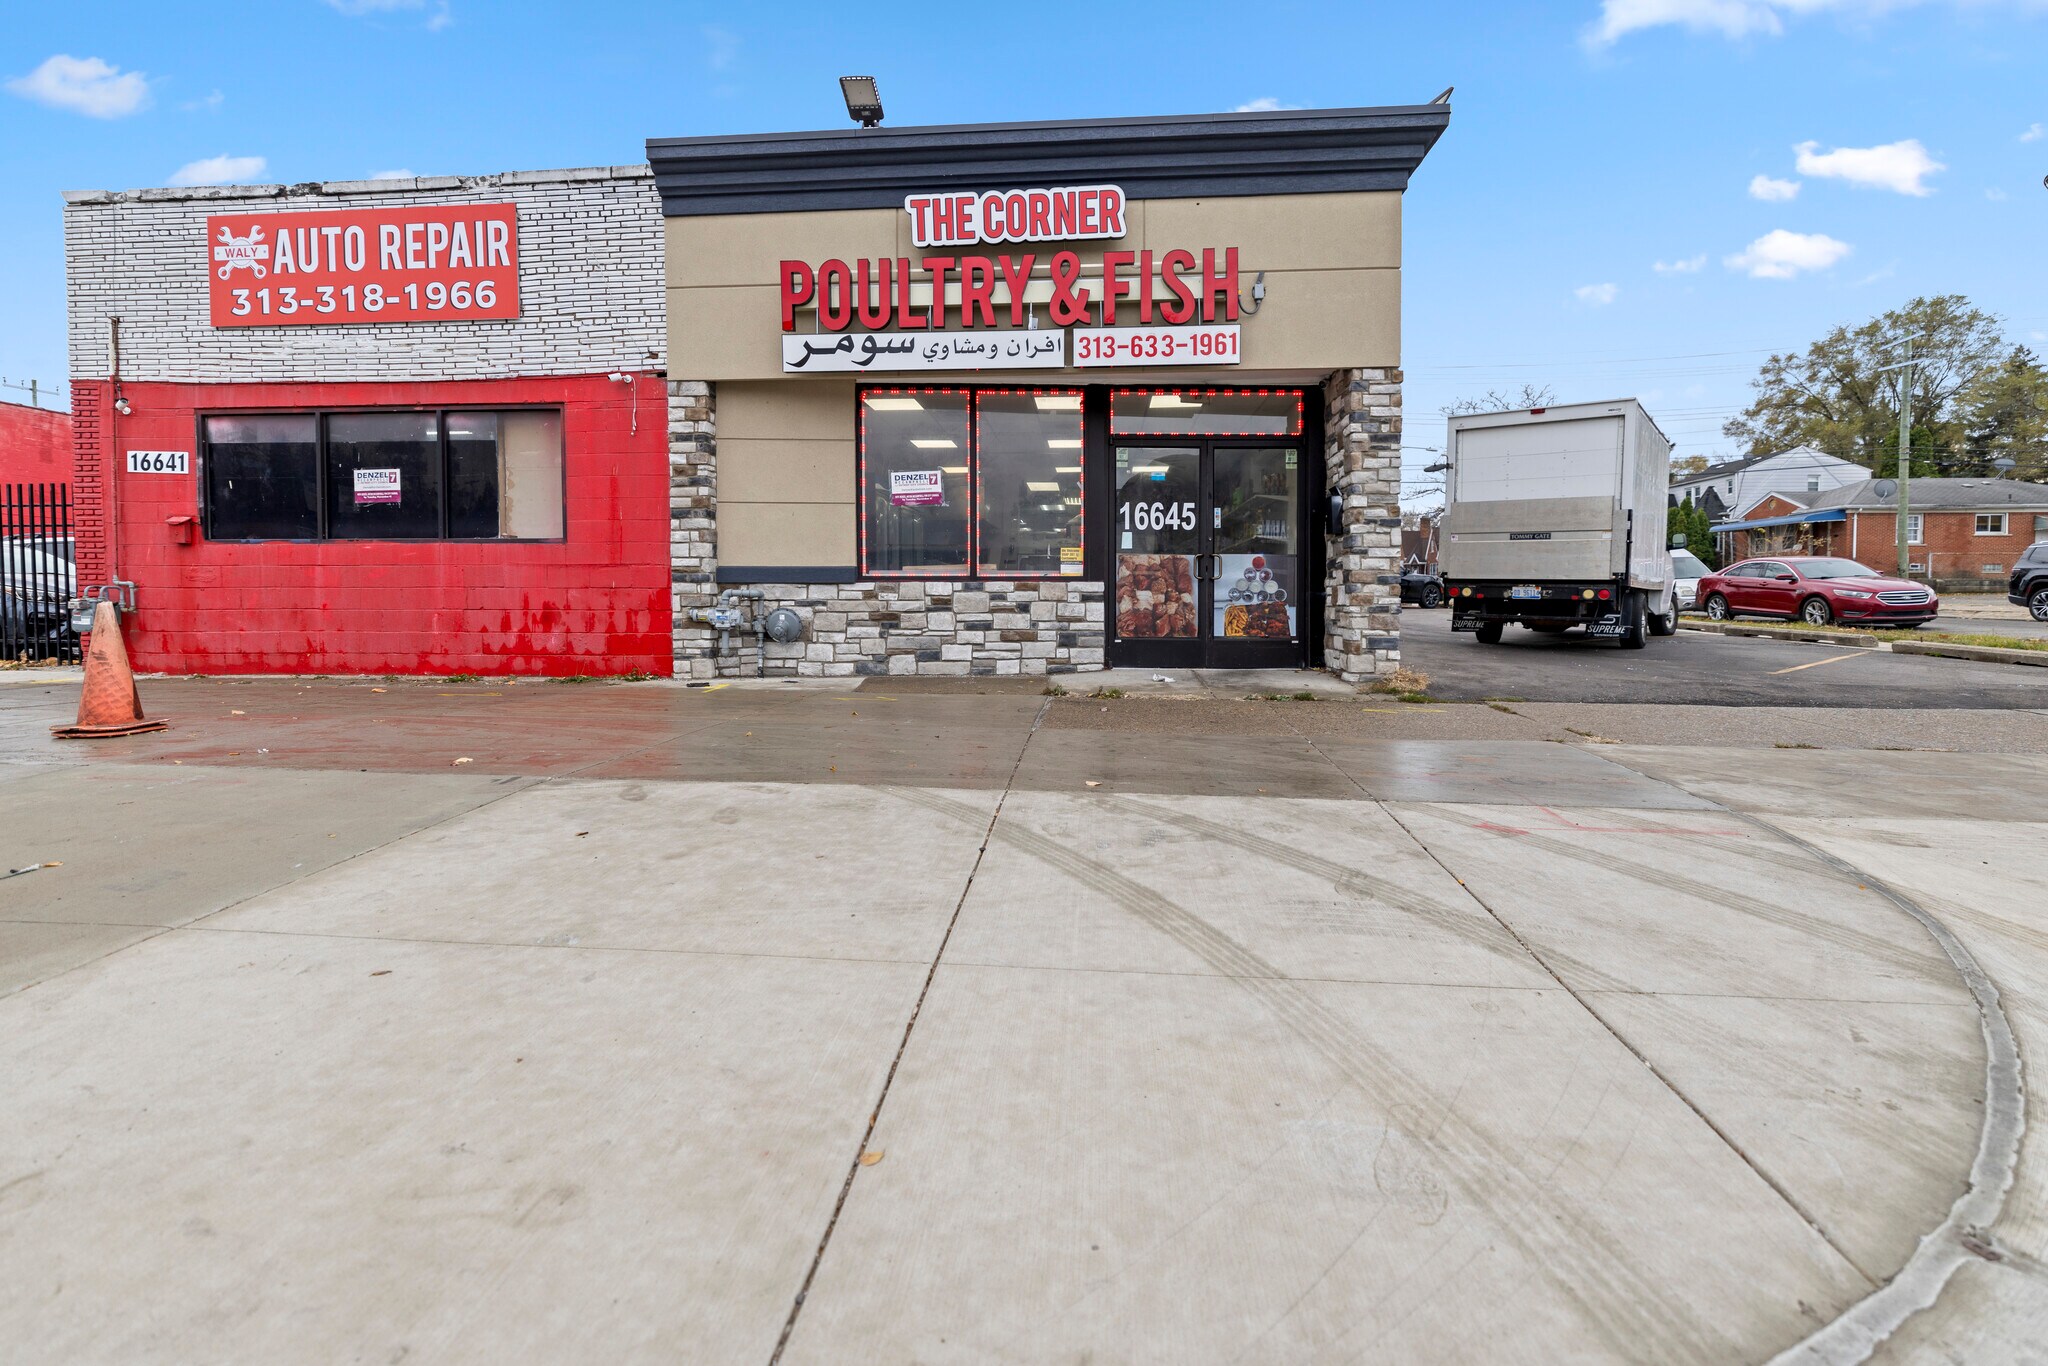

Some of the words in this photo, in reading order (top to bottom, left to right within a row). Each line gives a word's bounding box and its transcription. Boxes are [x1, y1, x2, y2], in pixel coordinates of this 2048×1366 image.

[909, 196, 976, 242] THE
[982, 189, 1122, 239] CORNER
[224, 247, 258, 260] WALY
[272, 224, 366, 275] AUTO
[378, 219, 511, 271] REPAIR
[230, 279, 497, 316] 313-318-1966
[779, 252, 1037, 332] POULTRY
[1049, 250, 1092, 327] &
[1102, 246, 1240, 326] FISH
[785, 334, 916, 368] سومر
[1077, 332, 1238, 359] 313-633-1961
[130, 452, 185, 472] 16641
[1119, 501, 1196, 531] 16645
[1453, 619, 1485, 628] SUPREME
[1587, 624, 1626, 634] SUPREME
